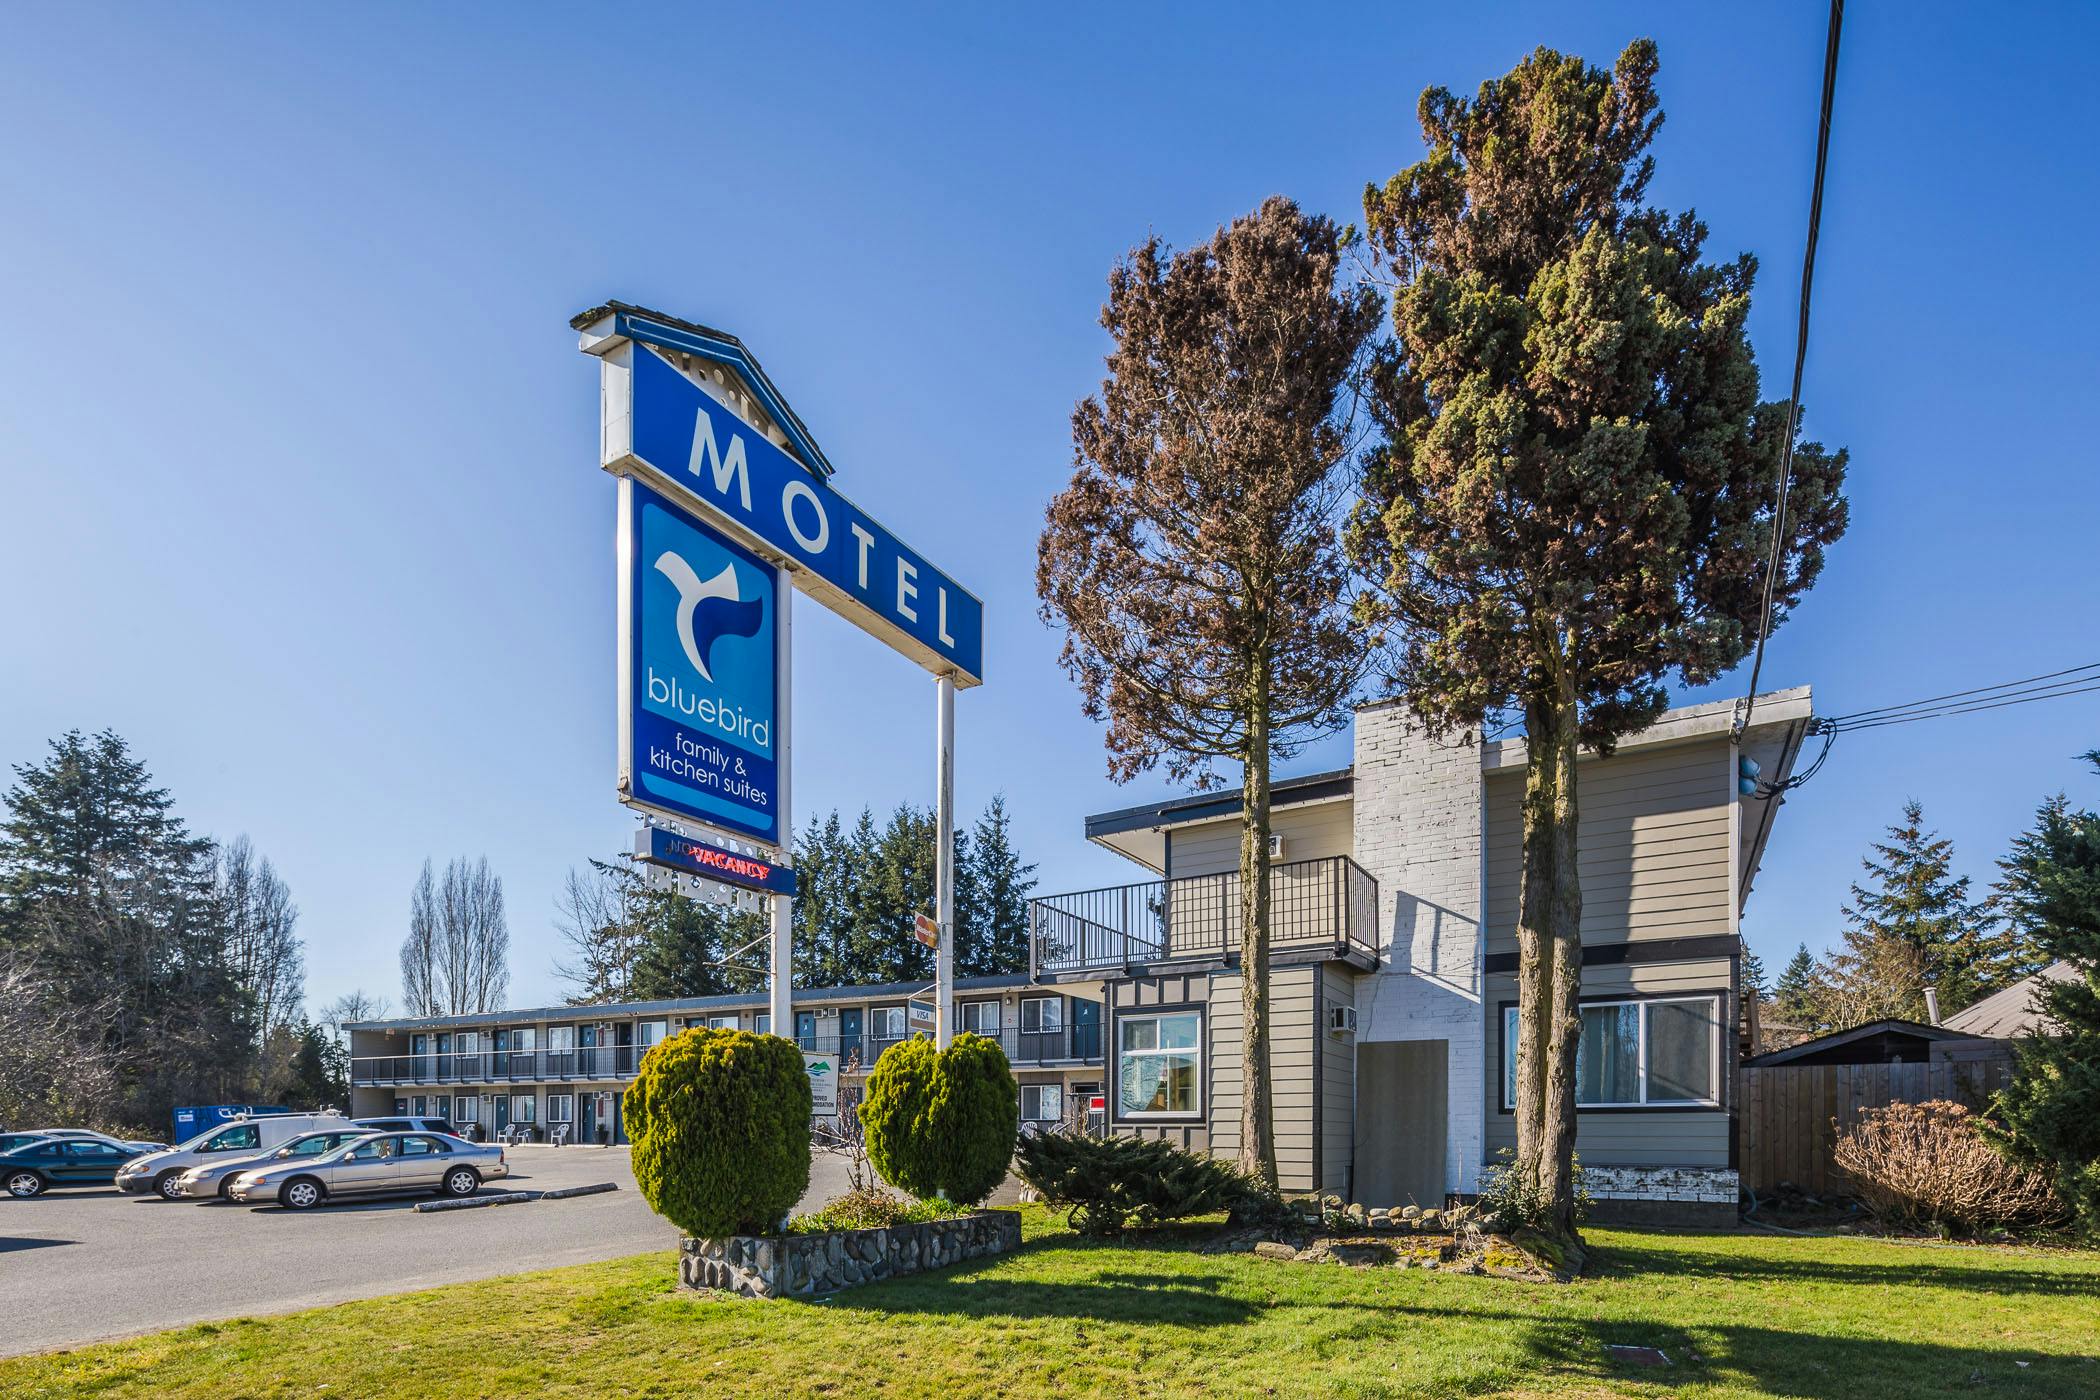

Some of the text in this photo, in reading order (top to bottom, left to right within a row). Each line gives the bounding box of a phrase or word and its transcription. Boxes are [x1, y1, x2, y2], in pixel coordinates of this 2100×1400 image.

[688, 407, 955, 649] MOTEL
[648, 666, 769, 748] bluebird
[650, 746, 767, 806] kitchen suites
[675, 732, 747, 776] family &
[691, 846, 770, 880] VACANCY
[916, 1010, 929, 1020] VISA
